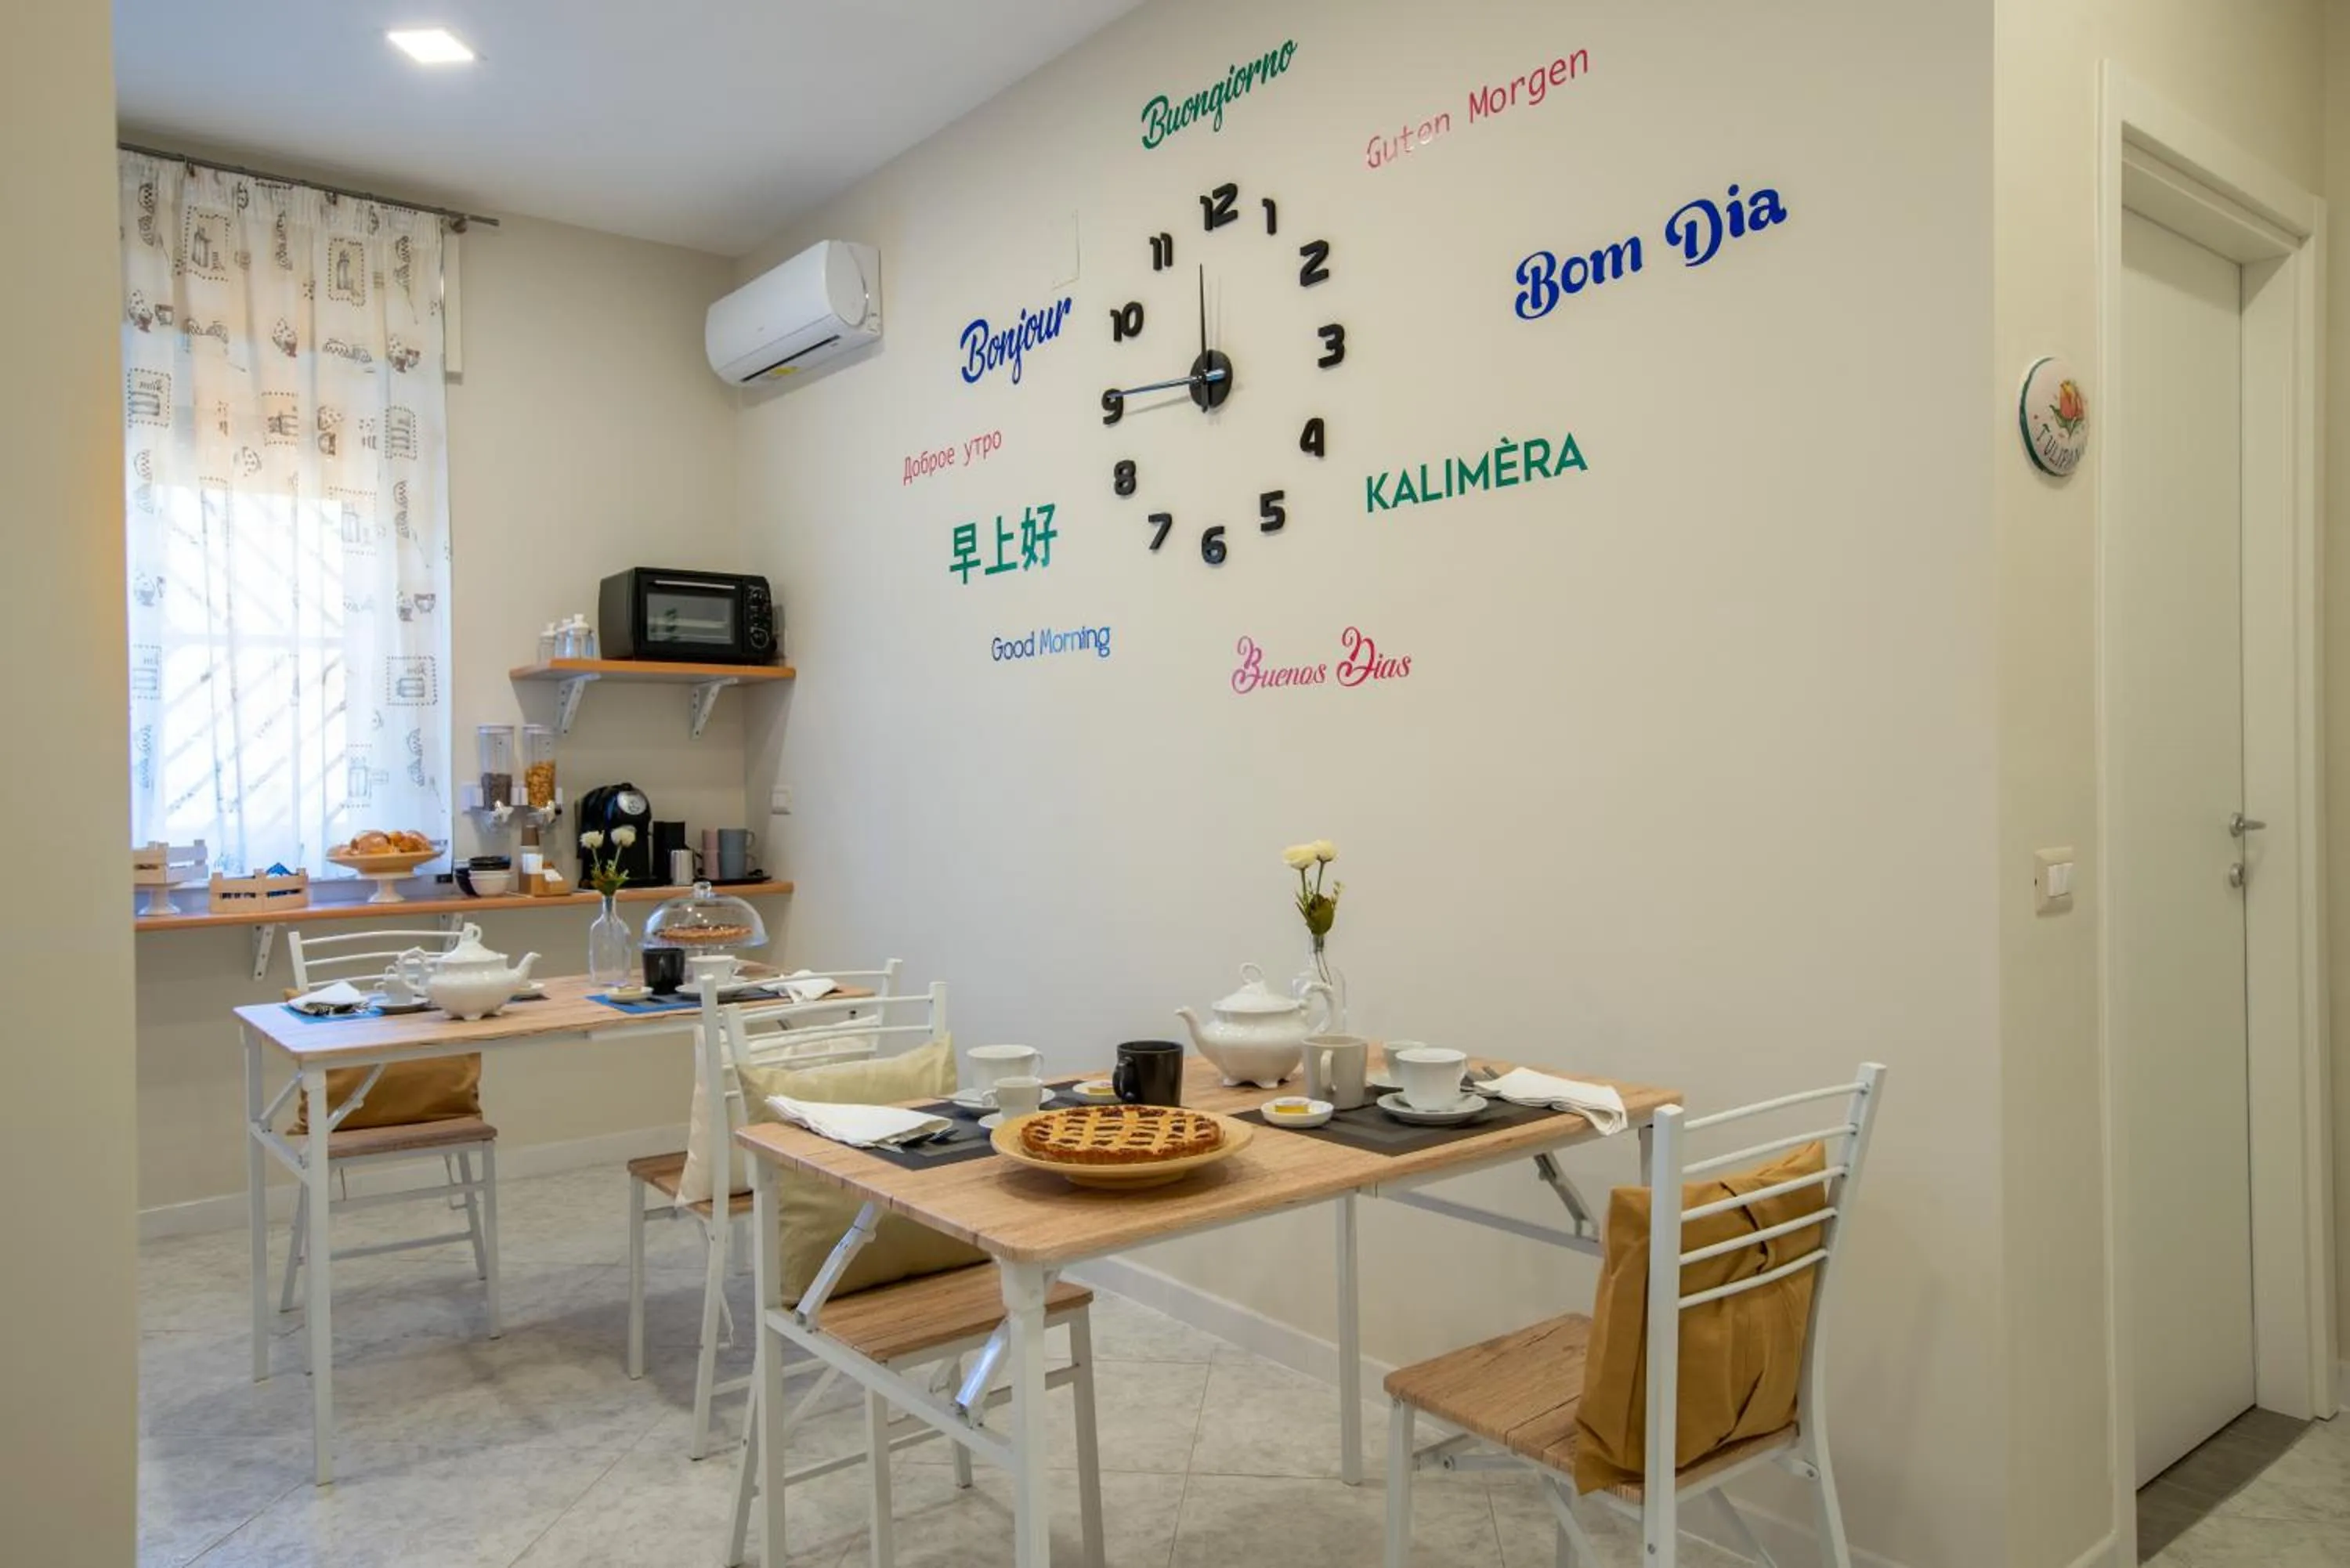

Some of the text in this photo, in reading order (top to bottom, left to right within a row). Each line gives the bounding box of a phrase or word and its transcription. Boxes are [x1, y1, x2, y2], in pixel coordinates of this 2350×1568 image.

[1141, 40, 1297, 150] Buongiorno
[1366, 49, 1588, 169] Guten Morgen
[1200, 183, 1238, 232] 12
[1262, 198, 1277, 235] 1
[1150, 233, 1173, 271] 11
[1300, 240, 1329, 287] 2
[1514, 184, 1788, 320] Bom Dia
[960, 297, 1072, 385] Bonjour
[1110, 302, 1144, 342] 10
[1318, 323, 1345, 369] 3
[1101, 388, 1124, 425] 9
[903, 430, 1002, 486] Доброе утро
[1300, 418, 1325, 457] 4
[1114, 460, 1137, 497] 8
[1366, 432, 1589, 513] KALIMÈRA
[1148, 513, 1173, 551] 7
[1260, 490, 1285, 533] 5
[949, 503, 1058, 585] 早上好
[1201, 526, 1227, 564] 6
[991, 626, 1111, 662] Good Morning
[1336, 626, 1412, 687] Dias
